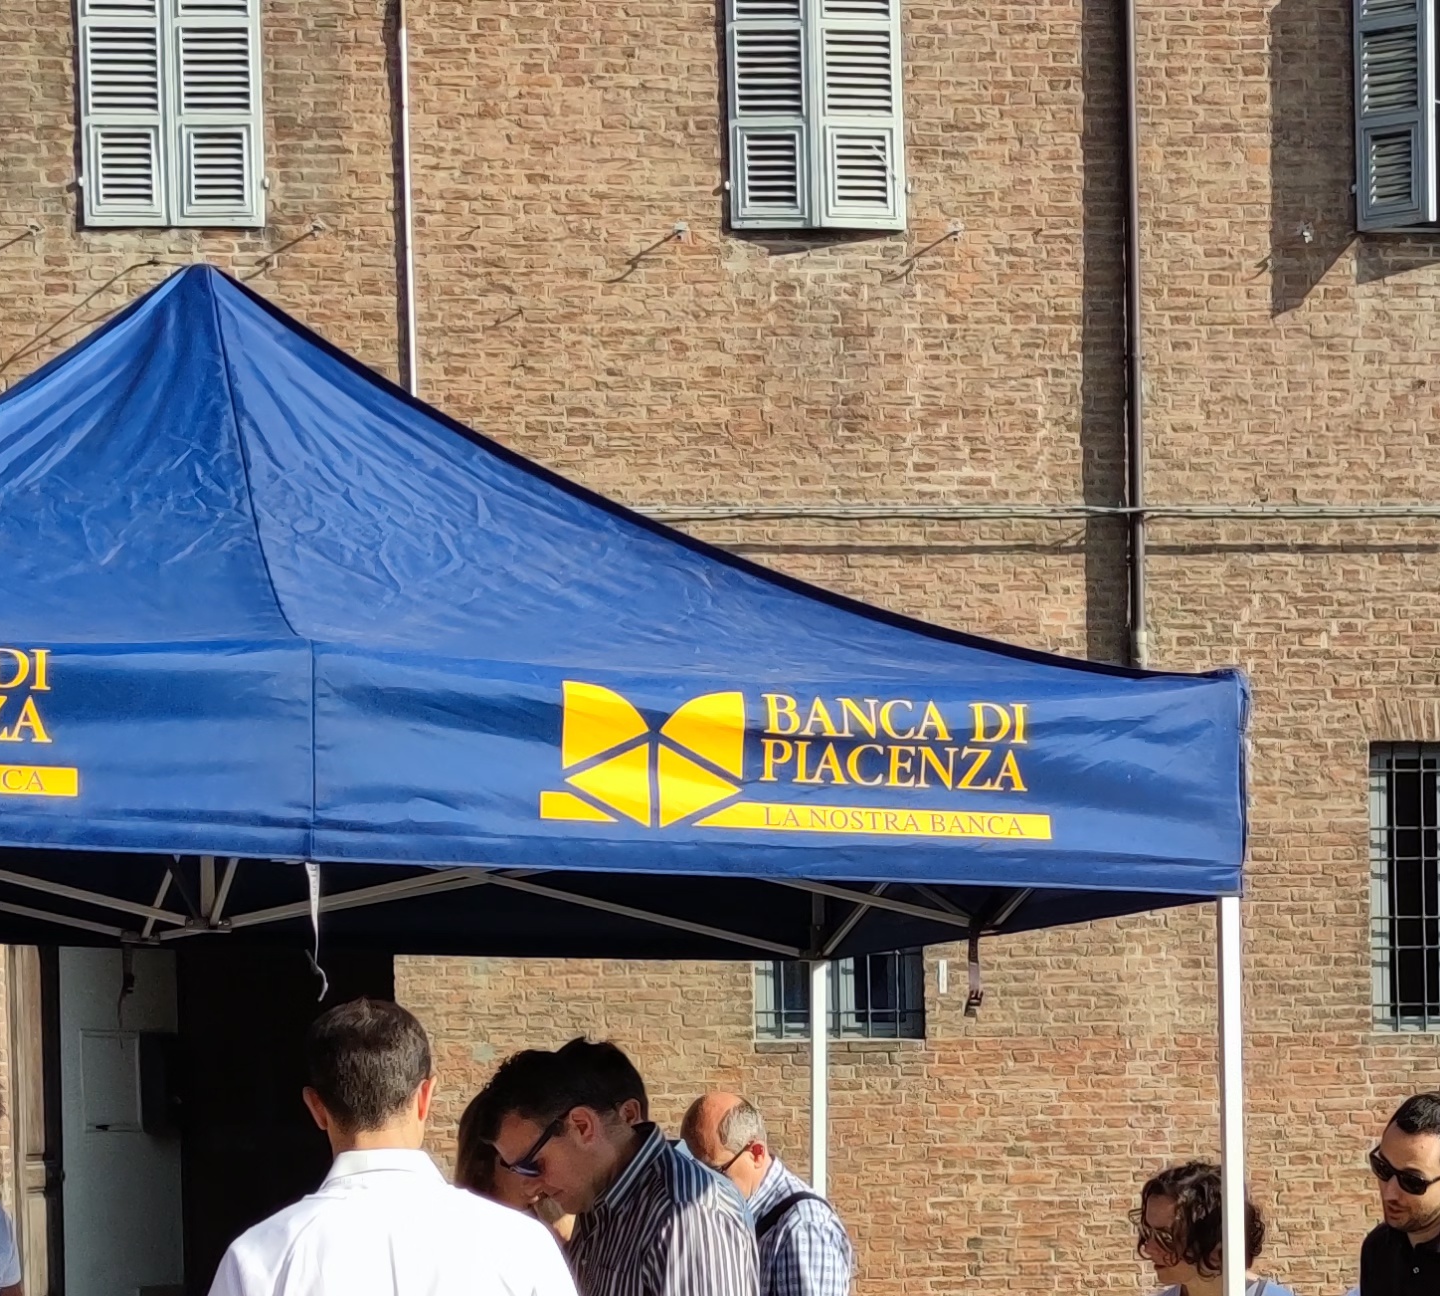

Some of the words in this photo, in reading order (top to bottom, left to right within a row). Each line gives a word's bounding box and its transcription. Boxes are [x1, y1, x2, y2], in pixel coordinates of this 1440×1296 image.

[760, 693, 953, 741] BANCA
[968, 702, 1029, 745] DI
[759, 738, 1029, 792] PIACENZA
[764, 806, 802, 827] LA
[809, 808, 920, 832] NOSTRA
[930, 813, 1026, 836] BANCA
